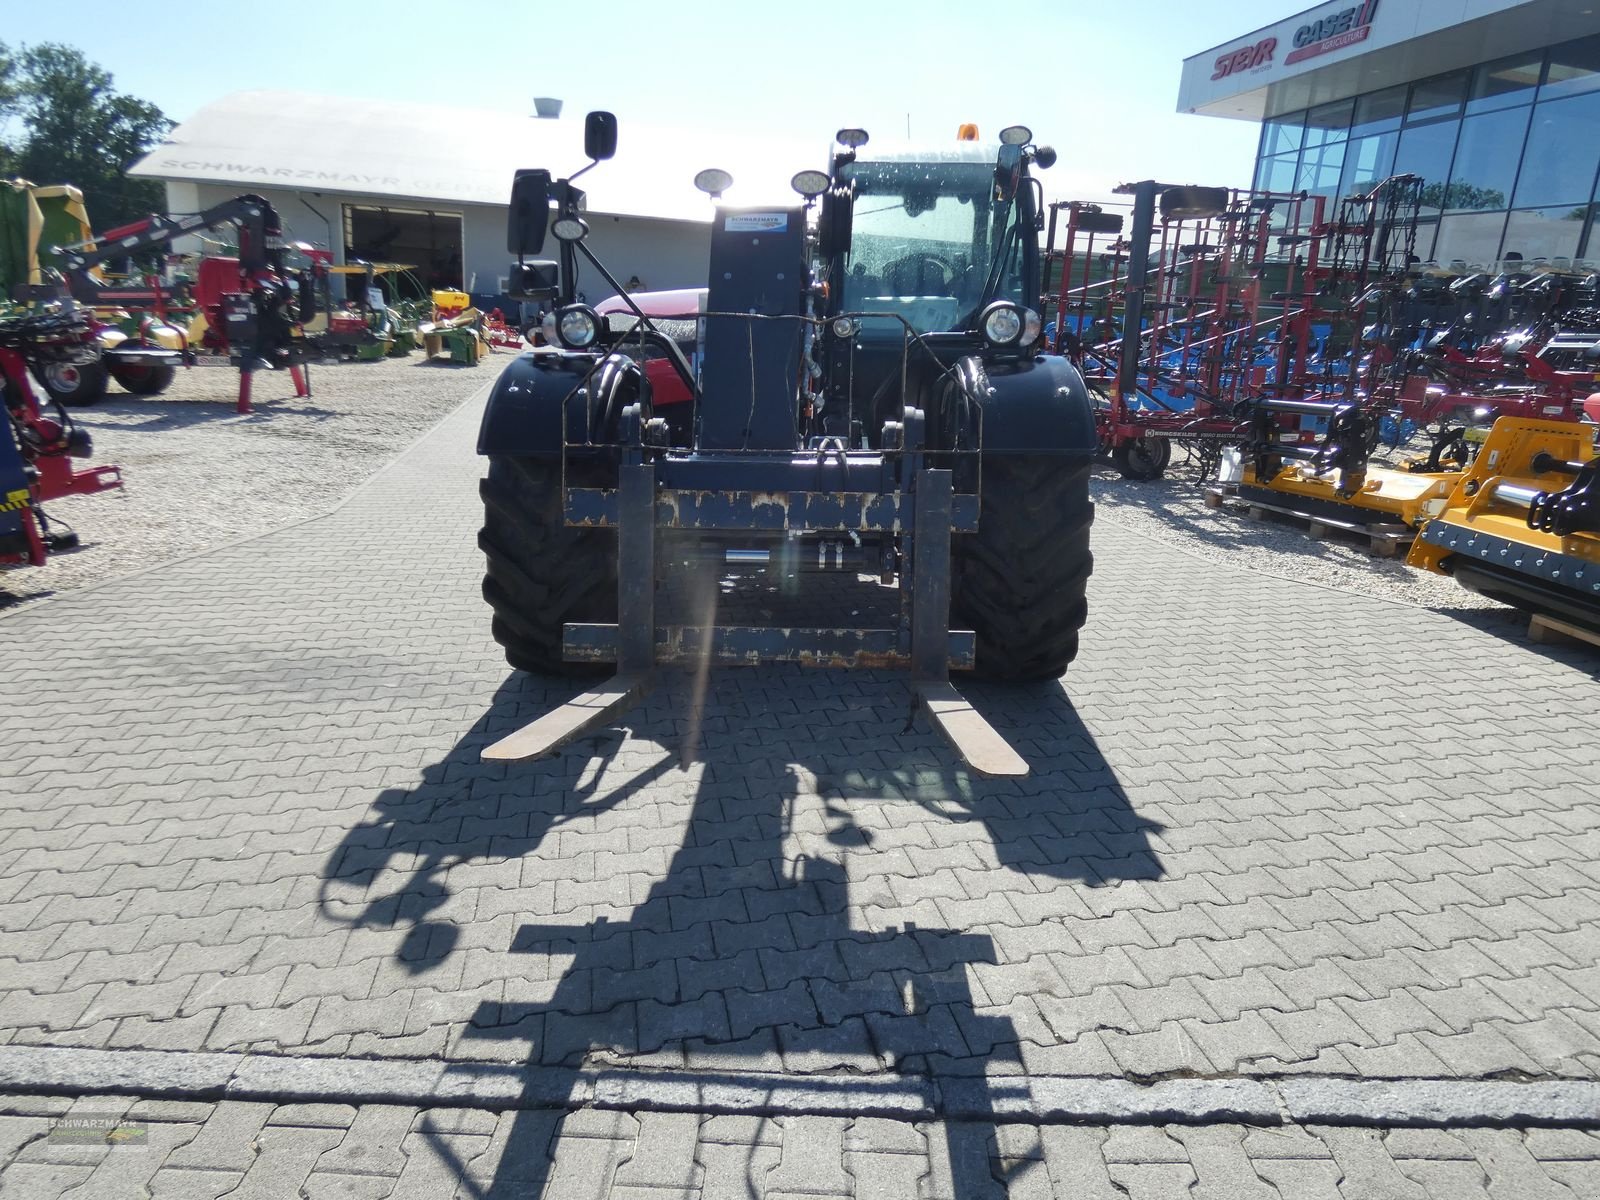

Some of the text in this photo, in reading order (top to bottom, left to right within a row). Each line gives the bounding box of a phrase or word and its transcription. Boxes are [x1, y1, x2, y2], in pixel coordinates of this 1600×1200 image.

[1293, 7, 1356, 48] CASE
[1320, 29, 1364, 51] AGRICULTURE
[1210, 37, 1277, 80] STEYR
[159, 159, 400, 187] SCHWARZMAYR
